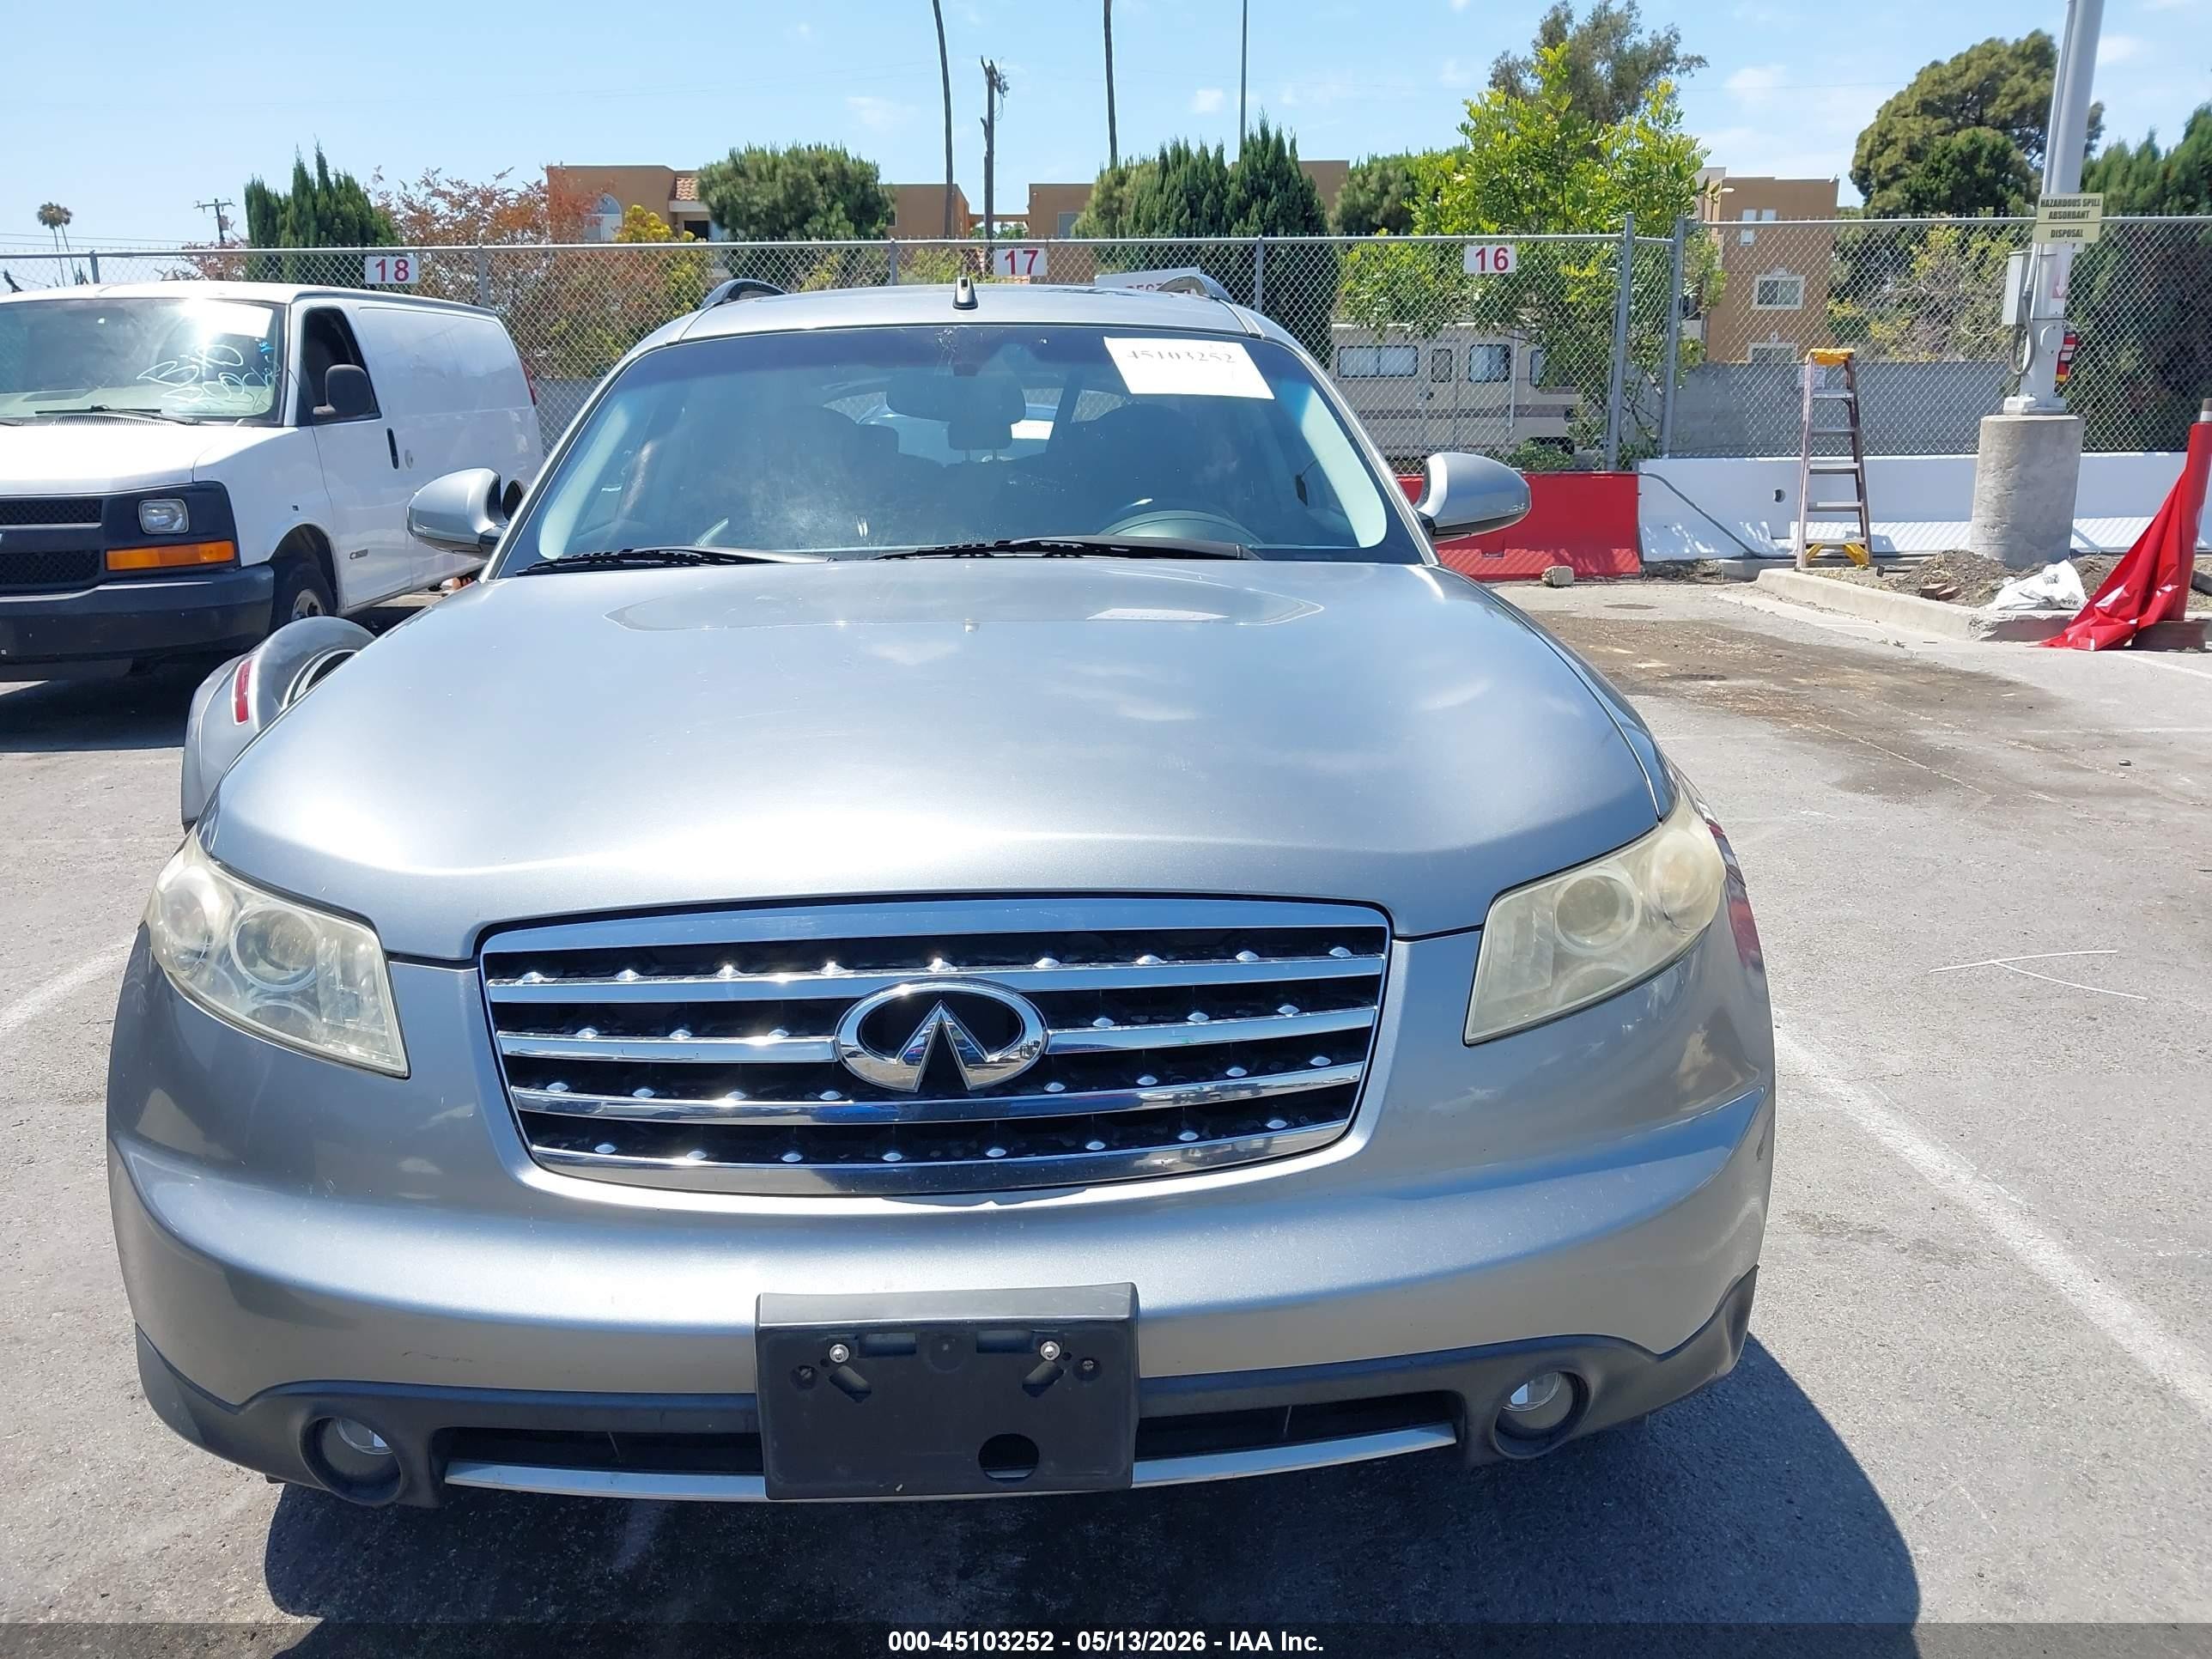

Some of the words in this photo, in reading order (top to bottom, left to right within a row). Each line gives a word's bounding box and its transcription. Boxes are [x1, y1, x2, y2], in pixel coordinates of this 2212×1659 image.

[2040, 198, 2081, 207] HAZARDOUS
[2049, 210, 2090, 220] ABSORBANT
[2051, 229, 2083, 238] DISPOSAL
[1005, 250, 1039, 275] 17
[1475, 247, 1509, 271] 16
[375, 258, 410, 282] 18
